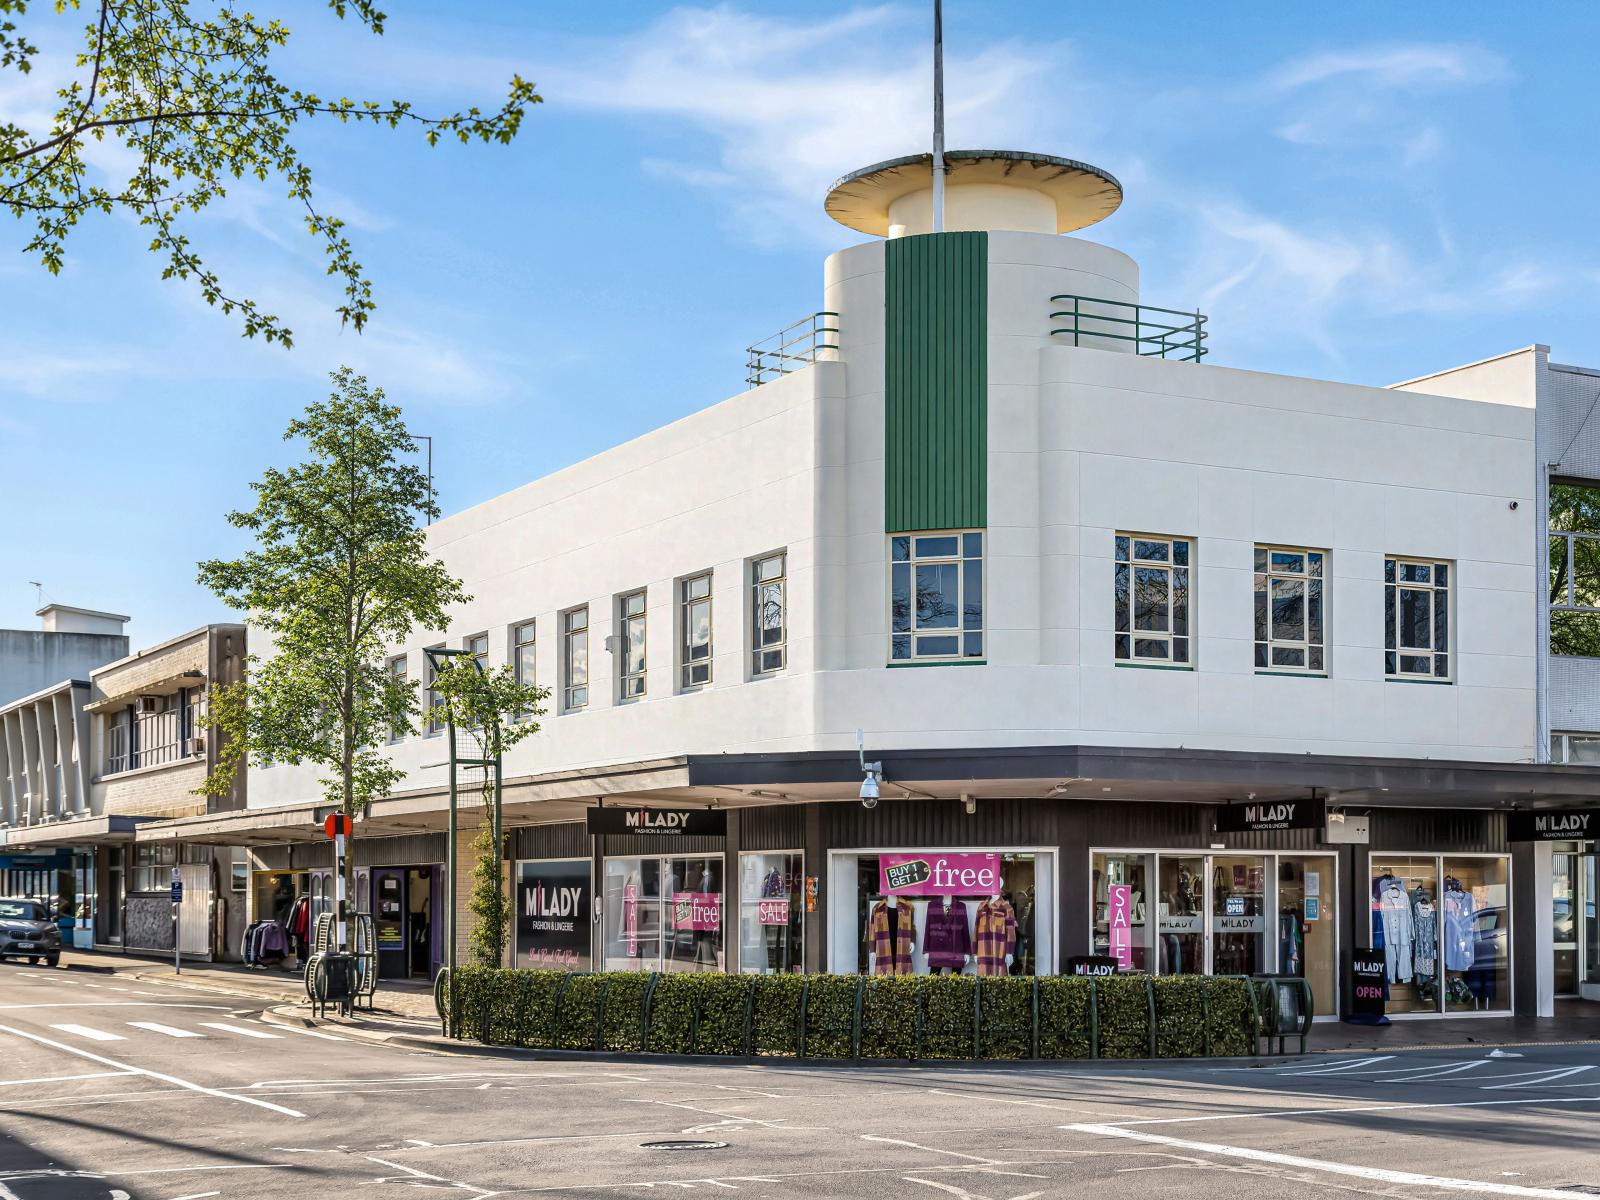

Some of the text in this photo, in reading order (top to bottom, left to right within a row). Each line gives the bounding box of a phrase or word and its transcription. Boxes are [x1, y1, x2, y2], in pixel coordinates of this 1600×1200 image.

[889, 864, 918, 878] BUY 1
[933, 859, 993, 887] free
[891, 873, 919, 887] GET 1
[692, 898, 718, 923] free
[760, 902, 787, 922] SALE
[1227, 904, 1243, 913] OPEN
[532, 921, 574, 932] FASHION & LINGERIE
[1114, 887, 1126, 967] SALE
[1356, 986, 1382, 999] OPEN
